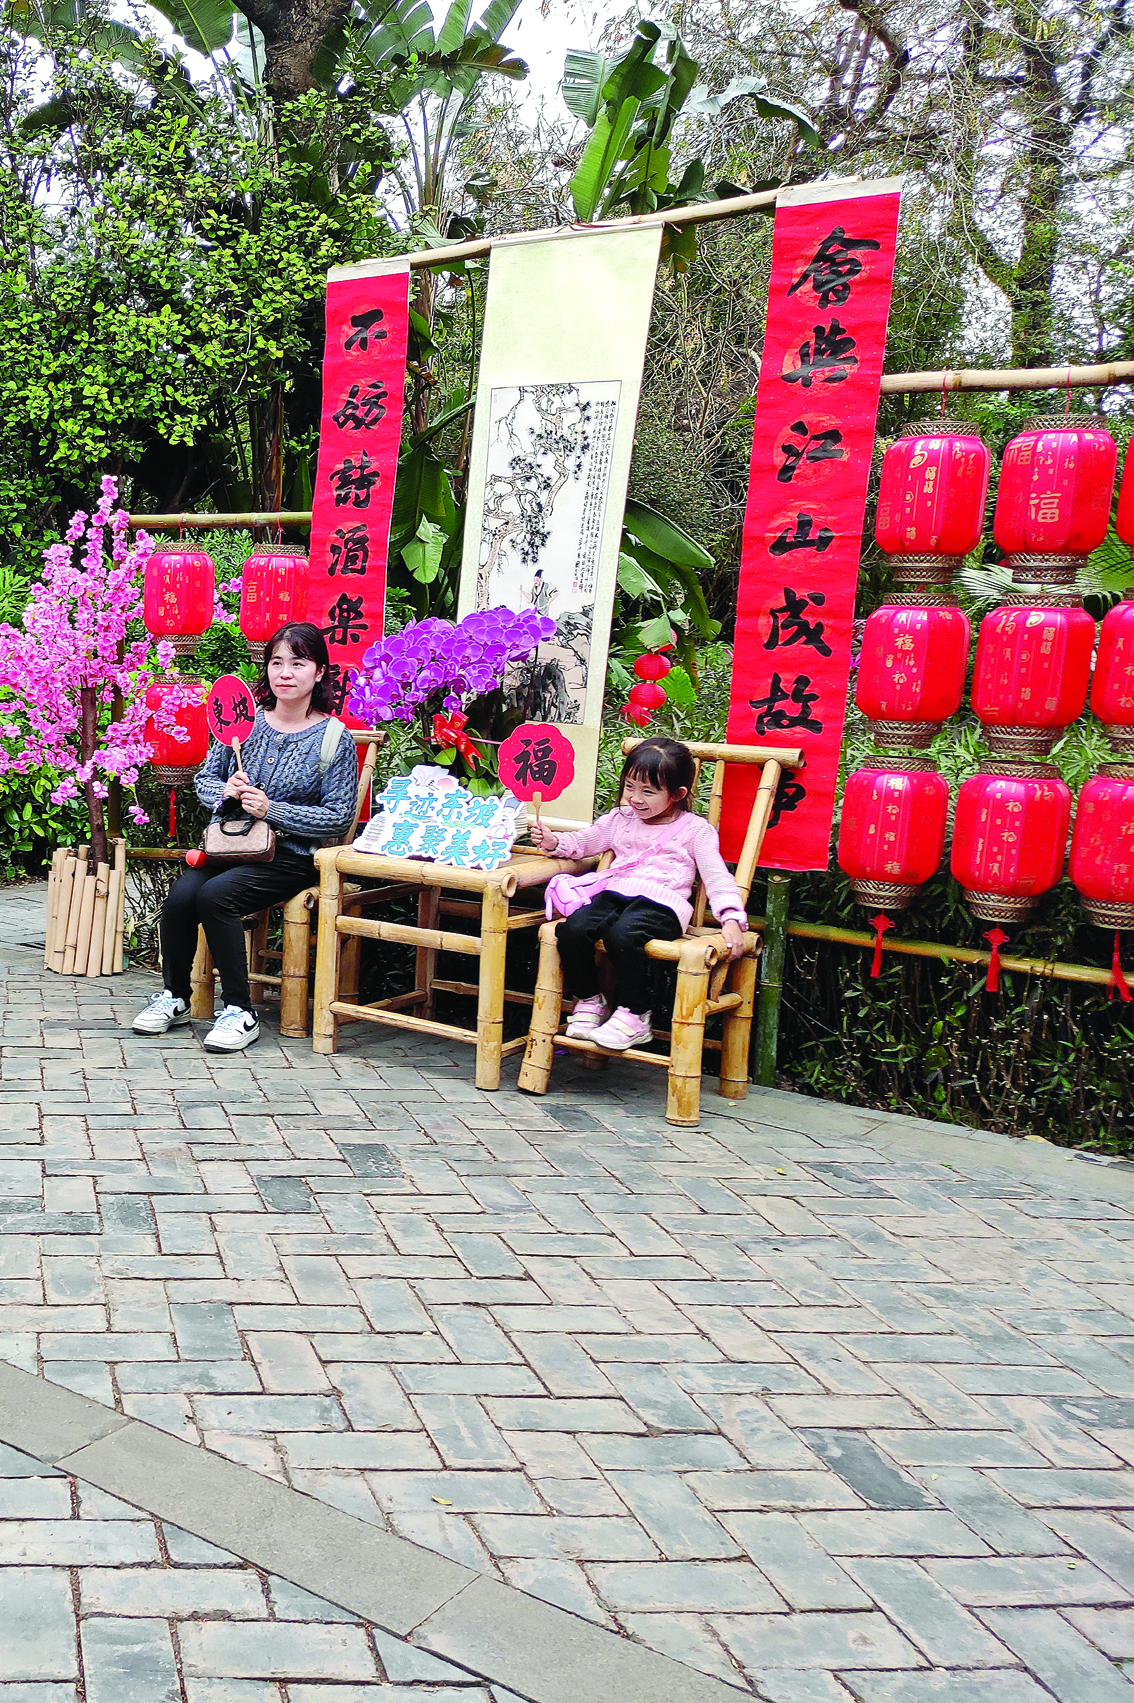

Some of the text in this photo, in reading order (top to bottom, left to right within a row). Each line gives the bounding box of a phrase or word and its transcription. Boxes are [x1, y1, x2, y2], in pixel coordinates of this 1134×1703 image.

[1027, 490, 1063, 523] 福
[163, 591, 178, 604] 福
[278, 590, 291, 602] 福
[893, 633, 915, 651] 福
[514, 738, 558, 787] 福
[886, 776, 905, 791] 福
[379, 778, 499, 829] 寻迹东坡
[381, 820, 507, 870] 惠聚美好
[883, 860, 902, 876] 福
